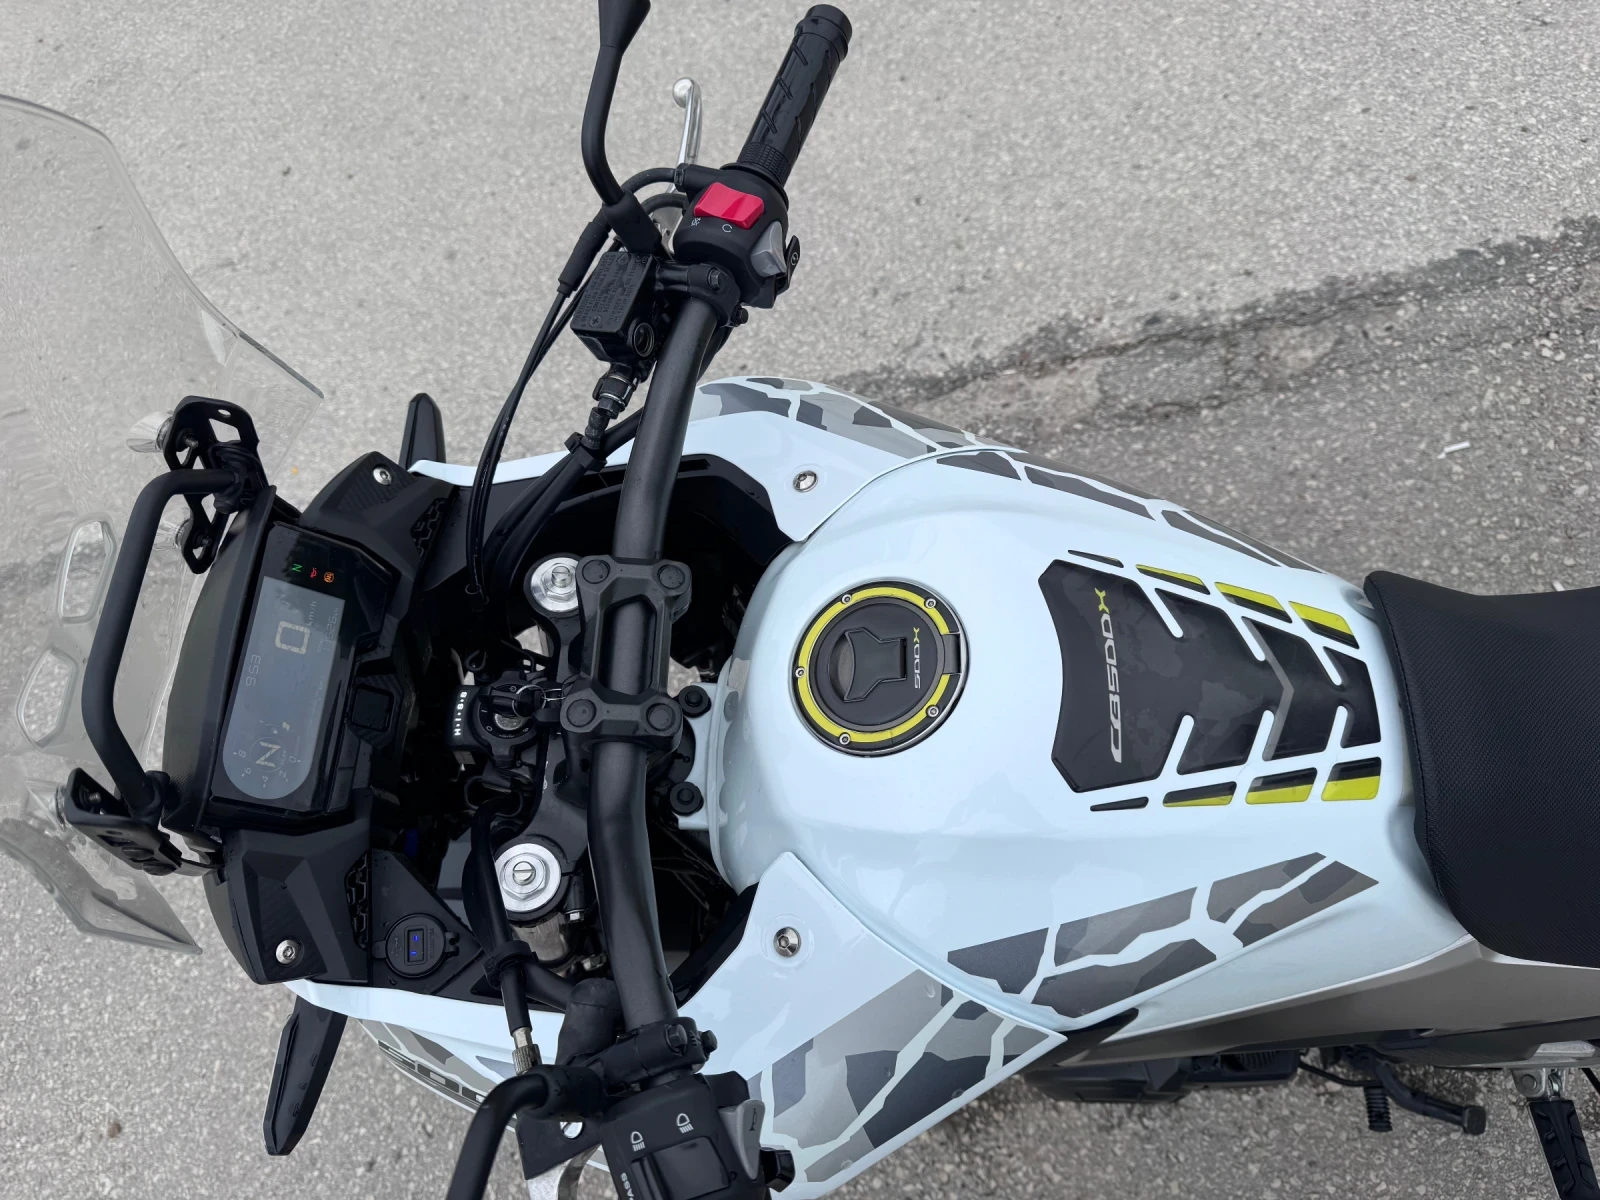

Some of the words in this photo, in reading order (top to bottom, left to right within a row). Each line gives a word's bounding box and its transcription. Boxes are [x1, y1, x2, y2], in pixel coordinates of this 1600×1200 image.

[292, 564, 302, 572] N
[275, 621, 310, 654] 0
[913, 627, 921, 689] 500X
[1094, 587, 1123, 764] CB500X
[255, 741, 280, 767] N
[621, 1172, 634, 1200] ASS
